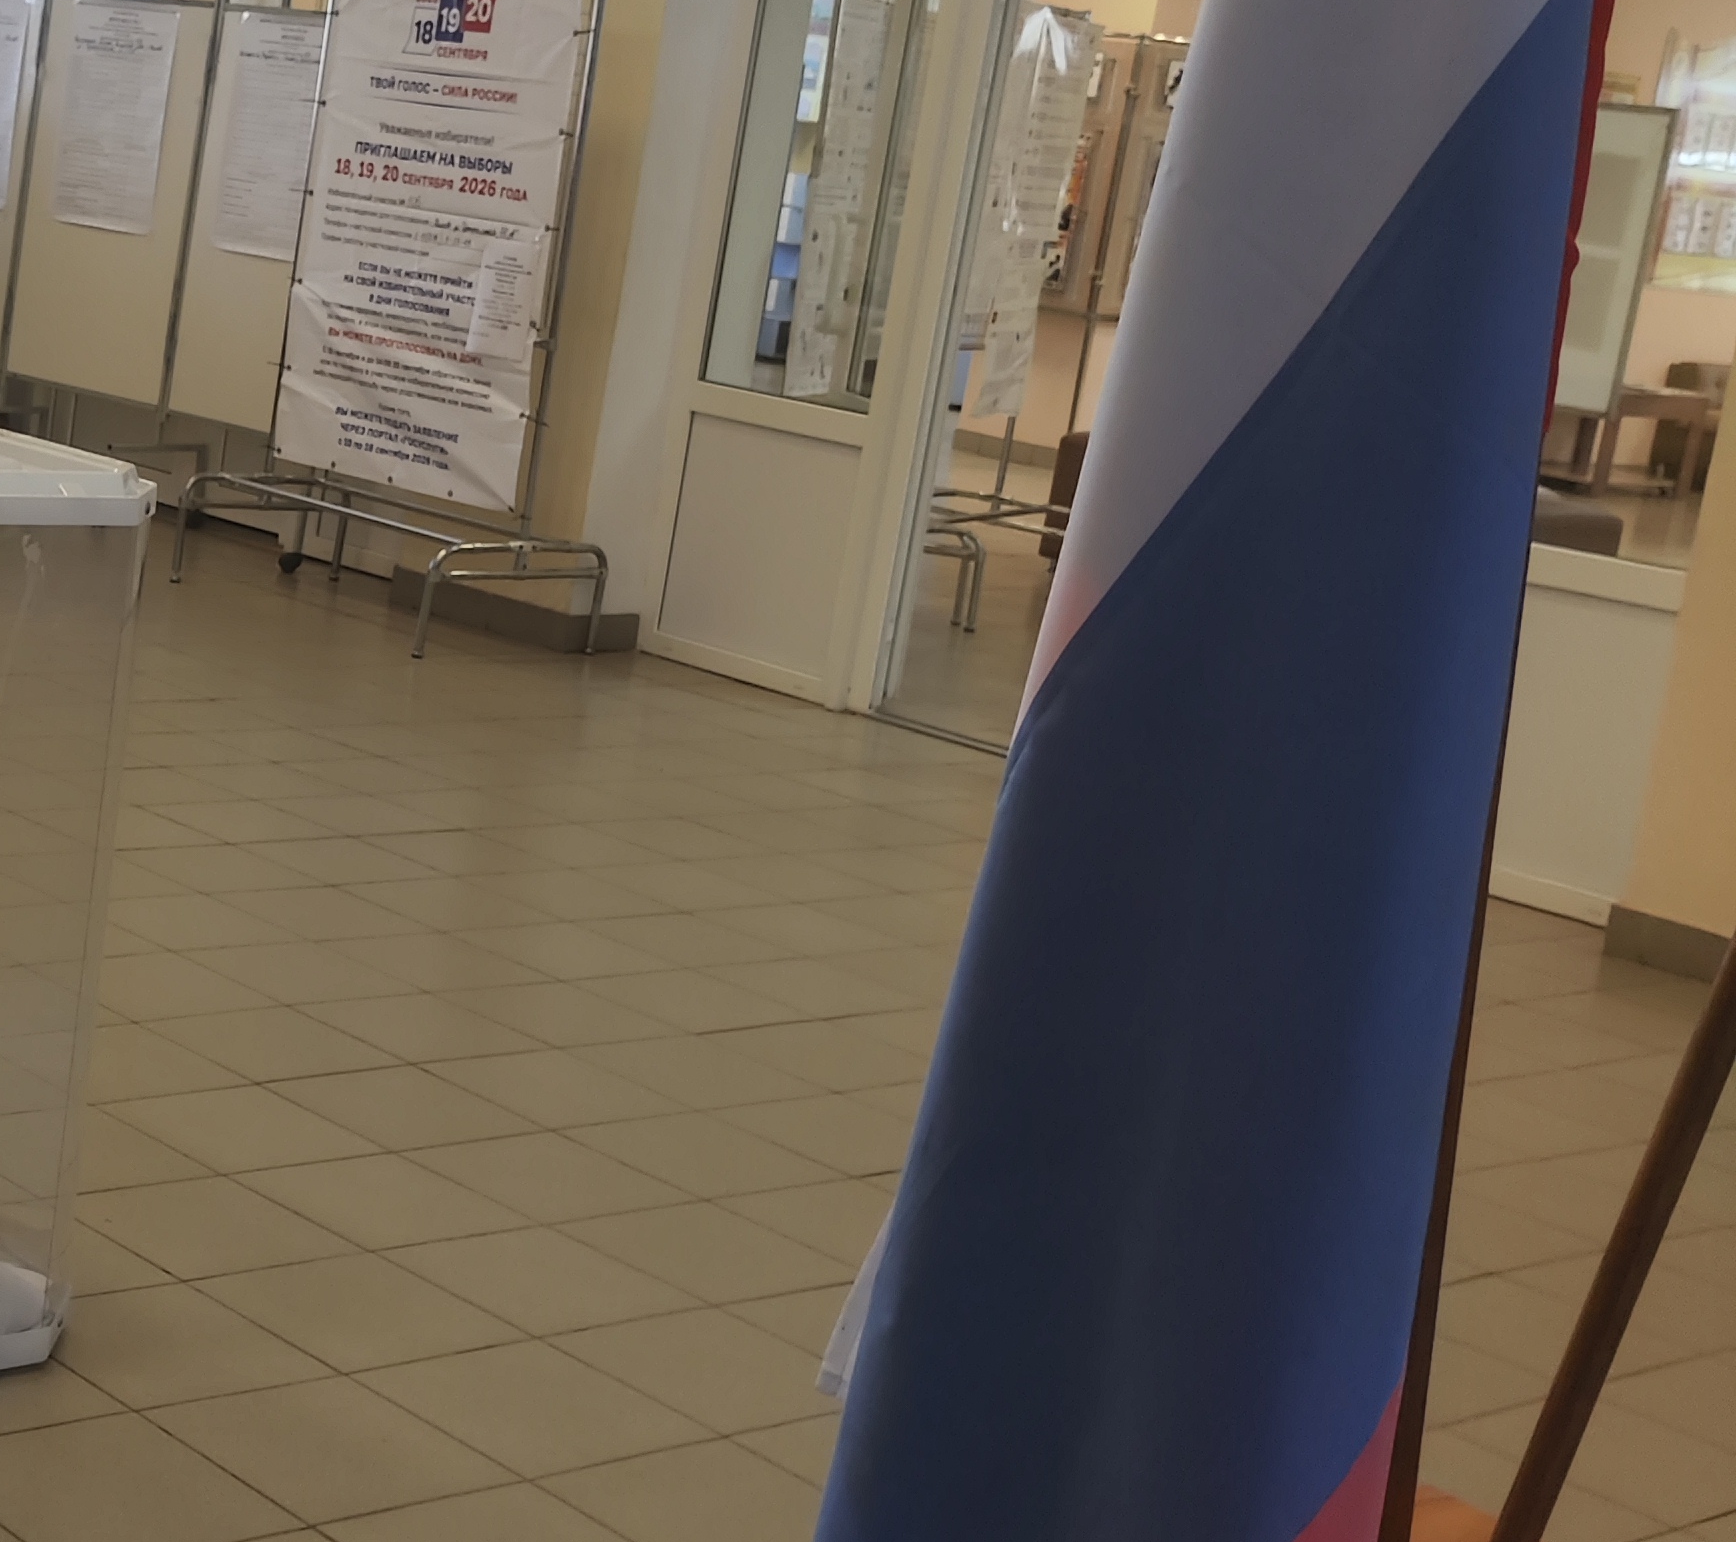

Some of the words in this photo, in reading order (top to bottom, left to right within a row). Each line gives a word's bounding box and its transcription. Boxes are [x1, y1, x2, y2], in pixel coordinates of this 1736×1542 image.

[414, 19, 434, 44] 18
[439, 6, 461, 34] 19
[436, 46, 488, 61] СЕНТЯБРЯ
[369, 75, 395, 90] ТВОЙ
[397, 79, 431, 94] ГОЛОС
[441, 84, 469, 98] СИЛА
[471, 88, 518, 104] РОССИИ!
[379, 121, 433, 140] Уважаемые
[355, 140, 437, 165] ПРИГЛАШАЕМ
[438, 153, 456, 168] НА
[458, 155, 513, 176] ВЫБОРЫ
[334, 157, 354, 179] 18,
[357, 160, 378, 183] 19,
[381, 164, 400, 182] 20
[401, 172, 454, 190] СЕНТЯБРЯ
[458, 176, 497, 197] 2026
[499, 186, 529, 202] ГОДА
[343, 274, 354, 284] НА
[355, 275, 376, 287] СВОЙ
[377, 280, 444, 300] ИЗБИРАТЕЛЬНЫЙ
[358, 261, 378, 272] ЕСЛИ
[379, 264, 391, 275] ВЫ
[393, 267, 403, 278] НЕ
[404, 270, 438, 284] МОЖЕТЕ
[439, 275, 473, 289] ПРИЙТИ
[375, 294, 392, 305] ДНИ
[393, 298, 450, 317] ГОЛОСОВАНИЯ
[328, 326, 340, 337] ВЫ
[342, 330, 374, 344] МОЖЕТЕ
[374, 336, 445, 359] ПРОГОЛОСОВАТЬ
[446, 350, 458, 361] НА
[334, 406, 348, 417] ВЫ
[350, 409, 382, 425] МОЖЕТЕ
[383, 417, 412, 433] ПОДАТЬ
[412, 424, 459, 445] ЗАЯВЛЕНИЕ
[340, 422, 366, 436] ЧЕРЕЗ
[366, 427, 399, 442] ПОРТАЛ
